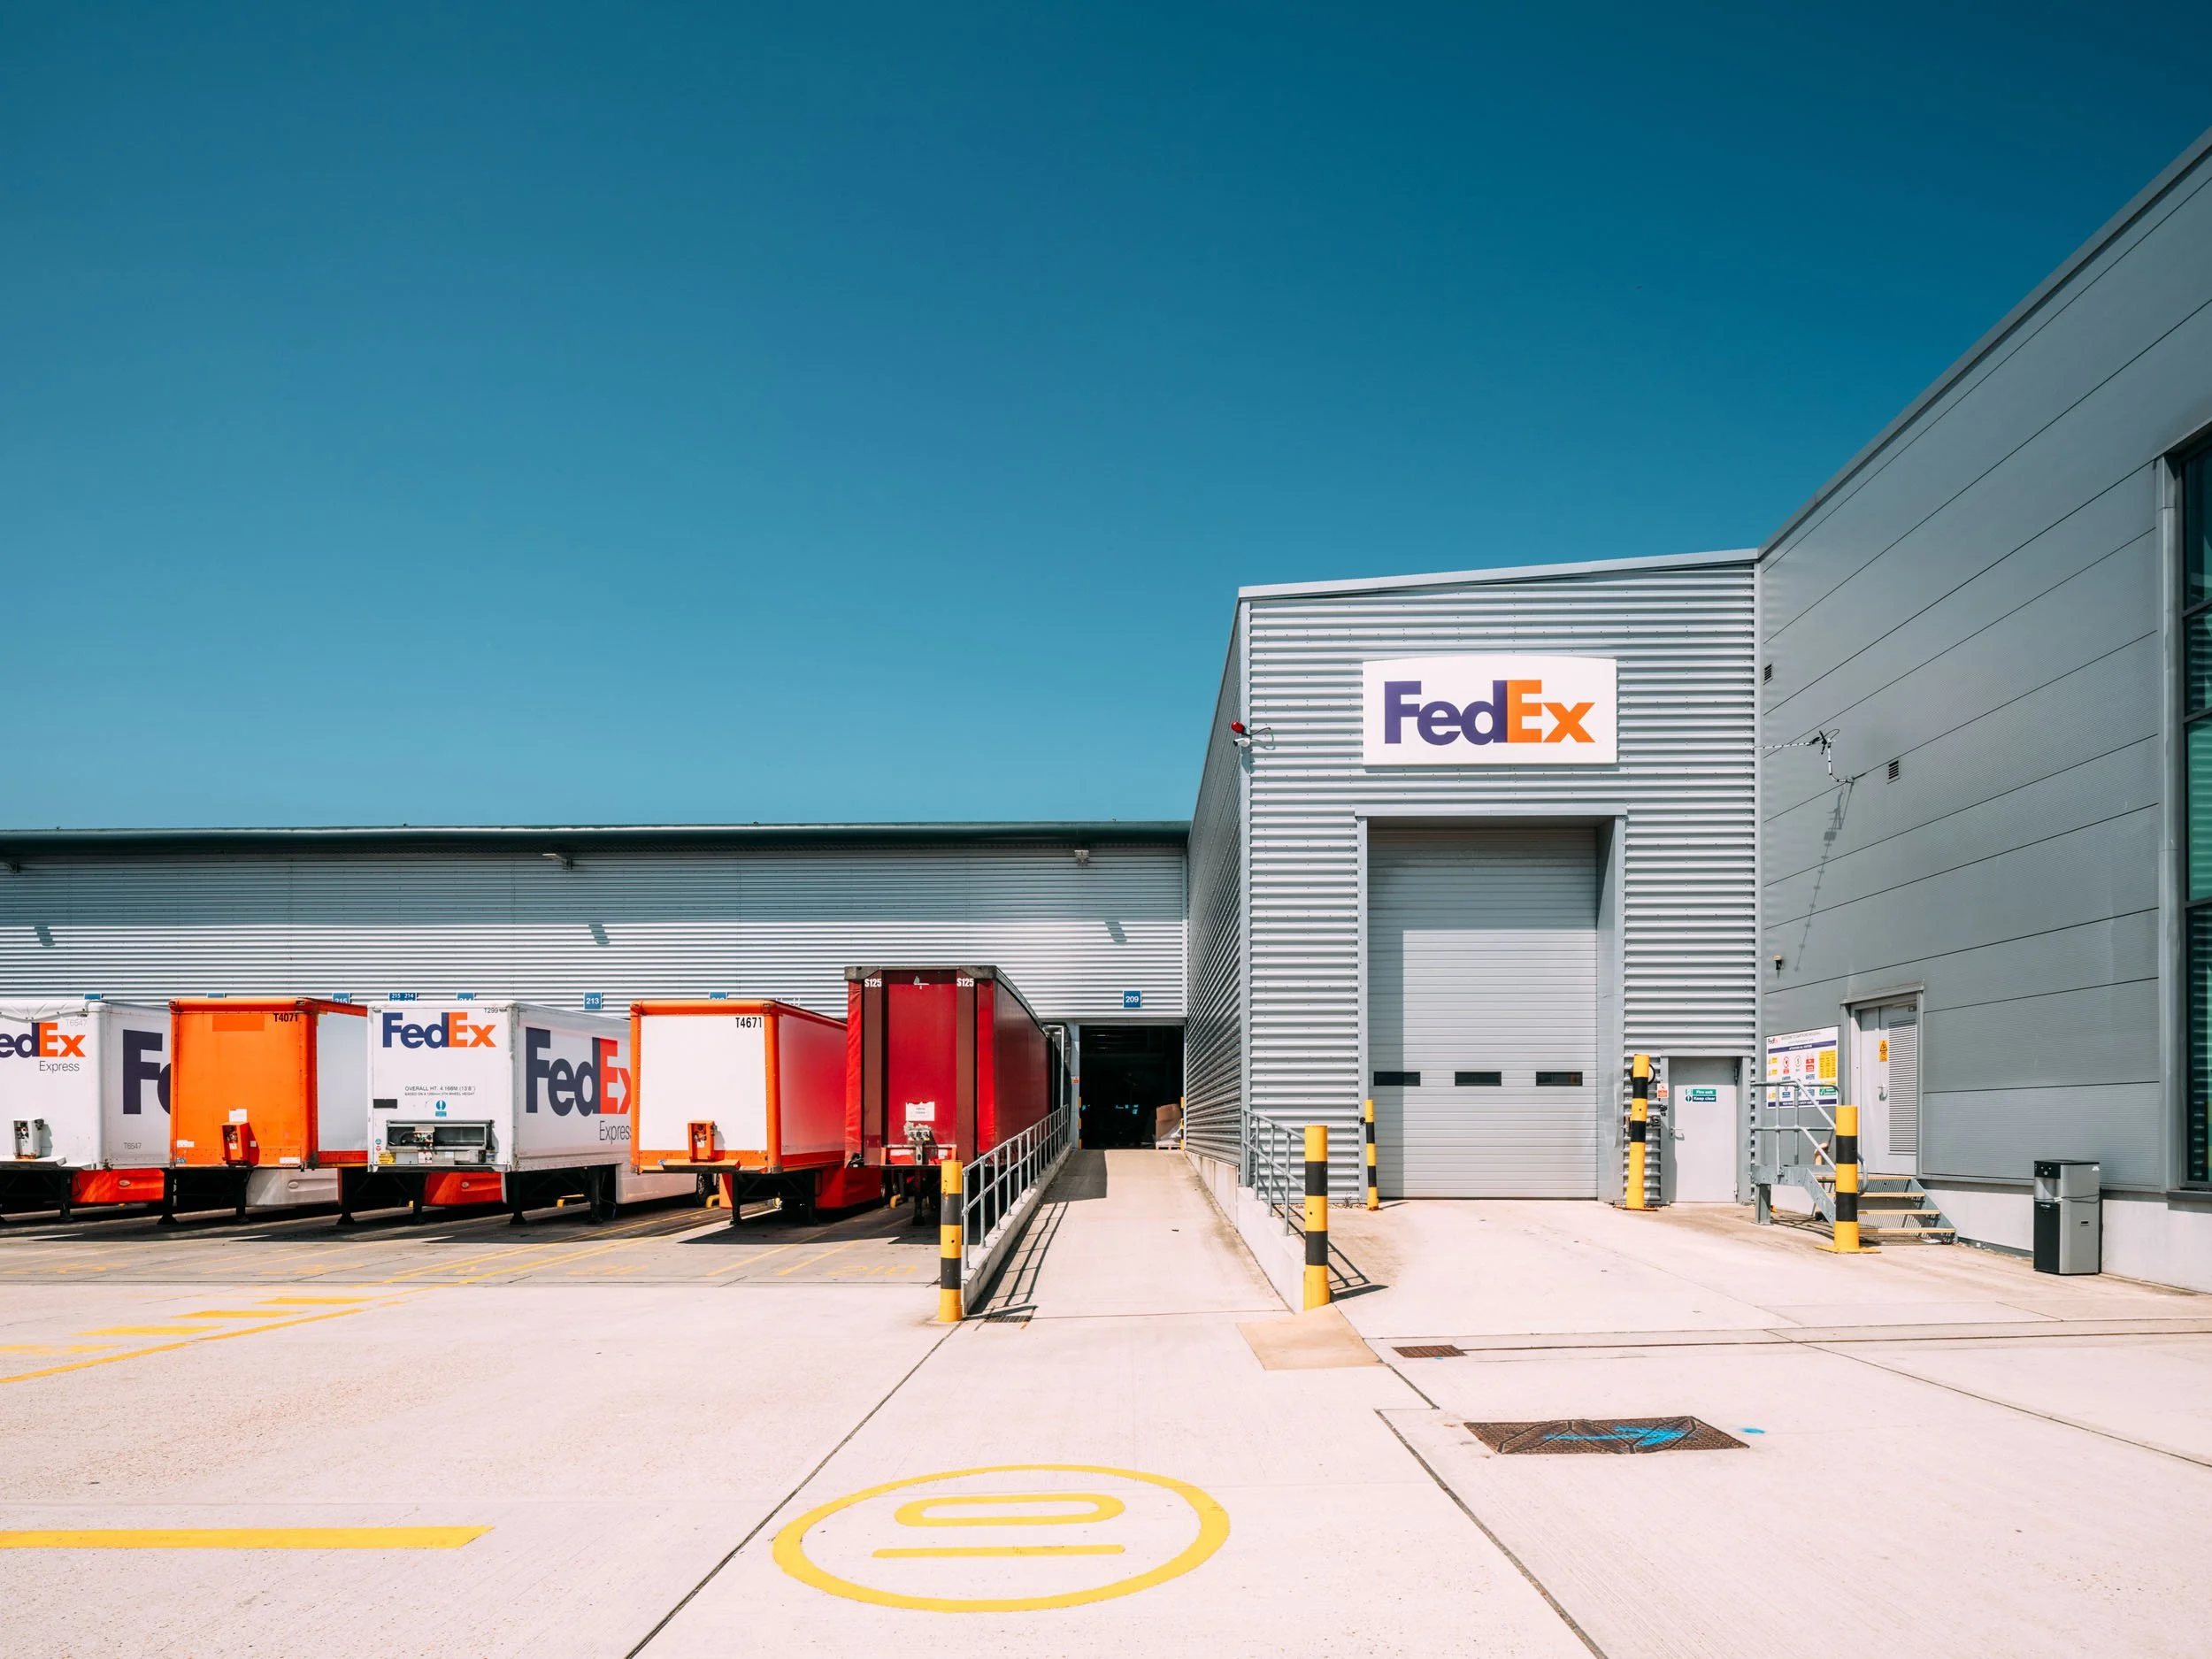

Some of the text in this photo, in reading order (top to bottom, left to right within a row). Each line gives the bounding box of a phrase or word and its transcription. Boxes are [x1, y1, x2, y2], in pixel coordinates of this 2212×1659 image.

[1385, 680, 1595, 745] FedEx
[864, 979, 882, 987] S125
[956, 978, 974, 987] S125
[273, 1013, 298, 1022] T4071
[735, 1018, 762, 1028] T4671
[382, 1012, 496, 1048] FedEx
[0, 1022, 86, 1058] edEx
[39, 1060, 80, 1073] Express
